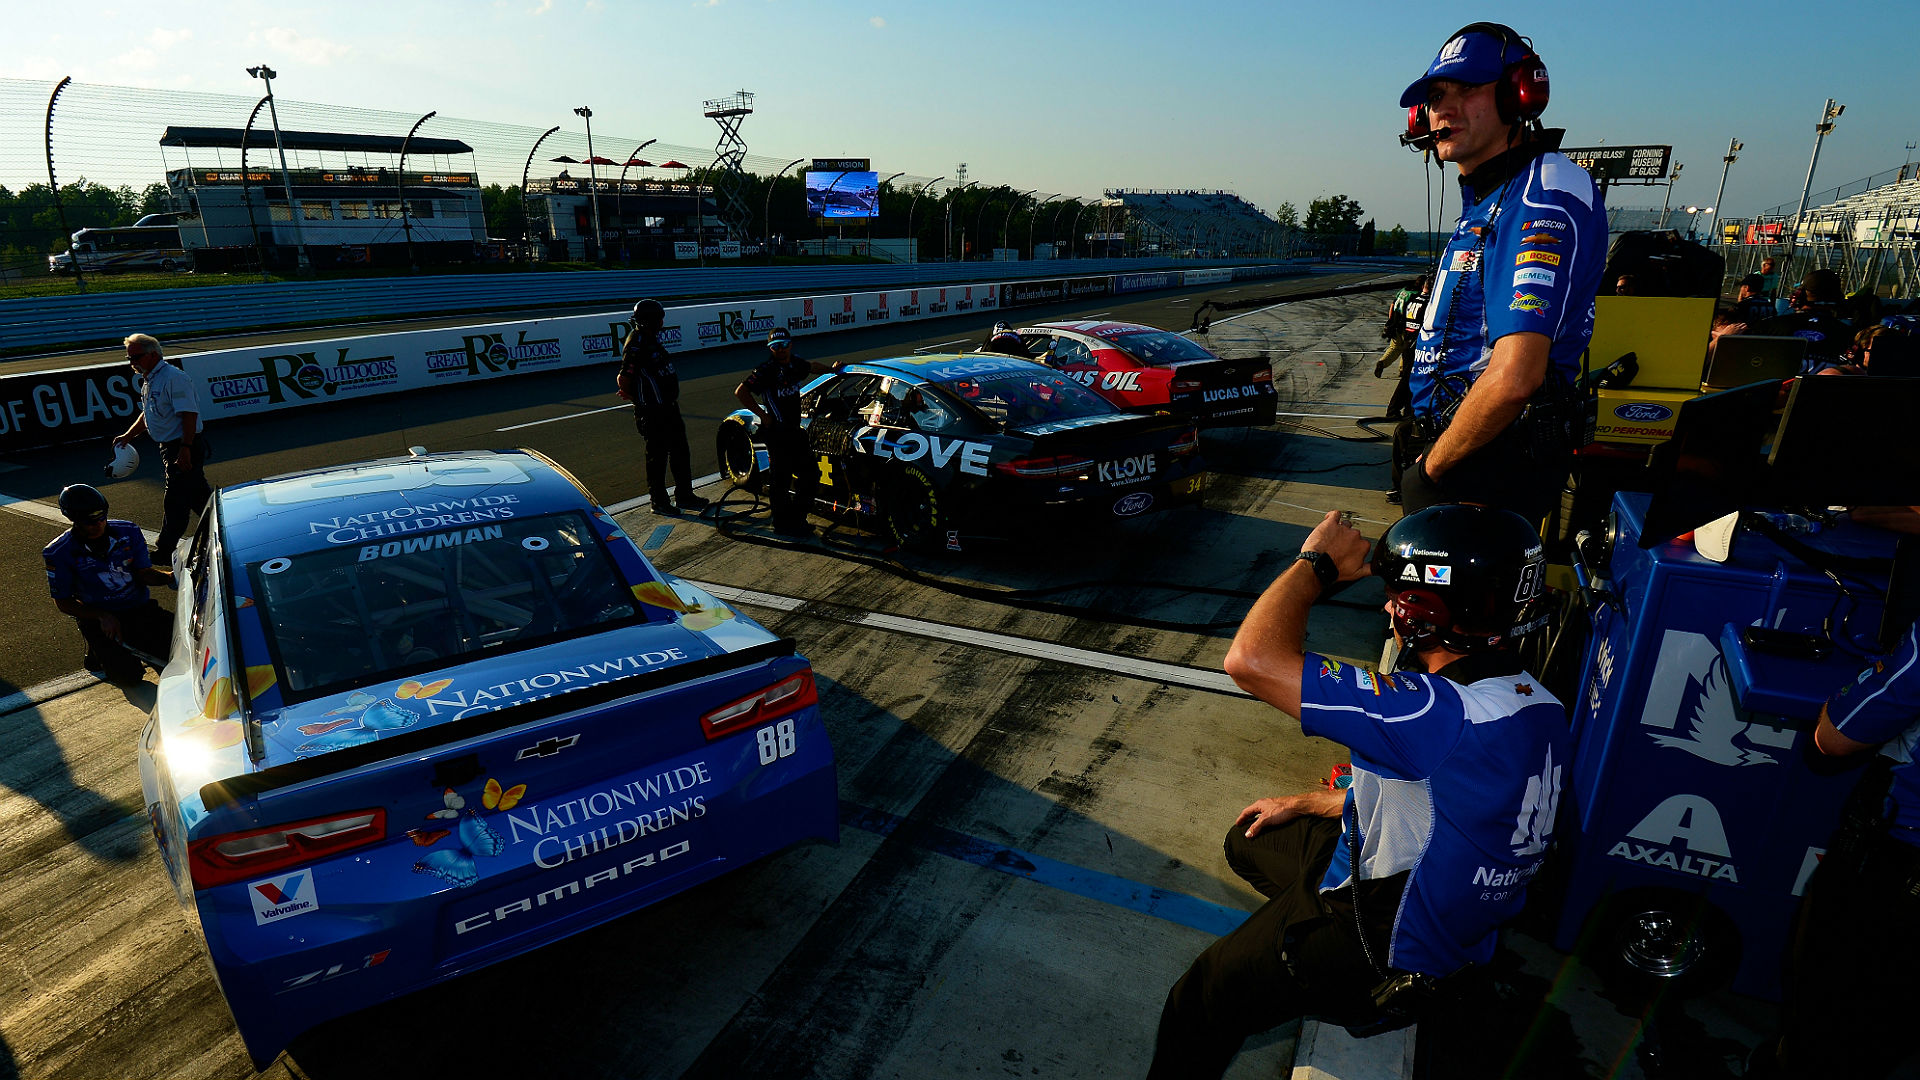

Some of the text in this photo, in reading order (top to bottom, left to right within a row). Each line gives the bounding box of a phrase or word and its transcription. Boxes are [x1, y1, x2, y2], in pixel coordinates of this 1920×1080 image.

[1577, 151, 1589, 160] DAY
[1590, 151, 1602, 159] FOR
[1602, 150, 1625, 159] GLASS!
[1633, 149, 1664, 158] CORNING
[838, 161, 865, 169] VISION
[1629, 166, 1660, 176] OF GLASS
[1631, 158, 1663, 167] MUSEUM
[1532, 220, 1567, 231] NASCAR
[1530, 252, 1559, 264] BOSCH
[1516, 271, 1552, 283] SIEMENS
[1512, 299, 1550, 310] SUNOCO
[582, 337, 613, 353] GREAT
[426, 351, 467, 370] GREAT
[210, 376, 266, 399] GREAT
[1202, 386, 1240, 403] LUCAS
[1241, 384, 1260, 397] OIL
[1625, 405, 1661, 420] Ford
[1612, 426, 1673, 437] PERFORMA
[1186, 477, 1201, 494] 34
[1120, 495, 1147, 513] Ford
[309, 494, 521, 535] NATIONWIDE
[326, 506, 515, 544] CHILDREN'S
[358, 524, 503, 562] BOWMAN
[1413, 548, 1449, 558] Nationwide
[426, 647, 688, 717] NATIONWIDE
[756, 718, 796, 766] 88
[507, 761, 712, 845] NATIONWIDE
[533, 795, 708, 870] CHILDREN'S
[1606, 840, 1740, 884] AXALTA
[455, 840, 691, 936] CAMARO
[1480, 890, 1489, 901] is
[261, 901, 310, 919] Valvoline
